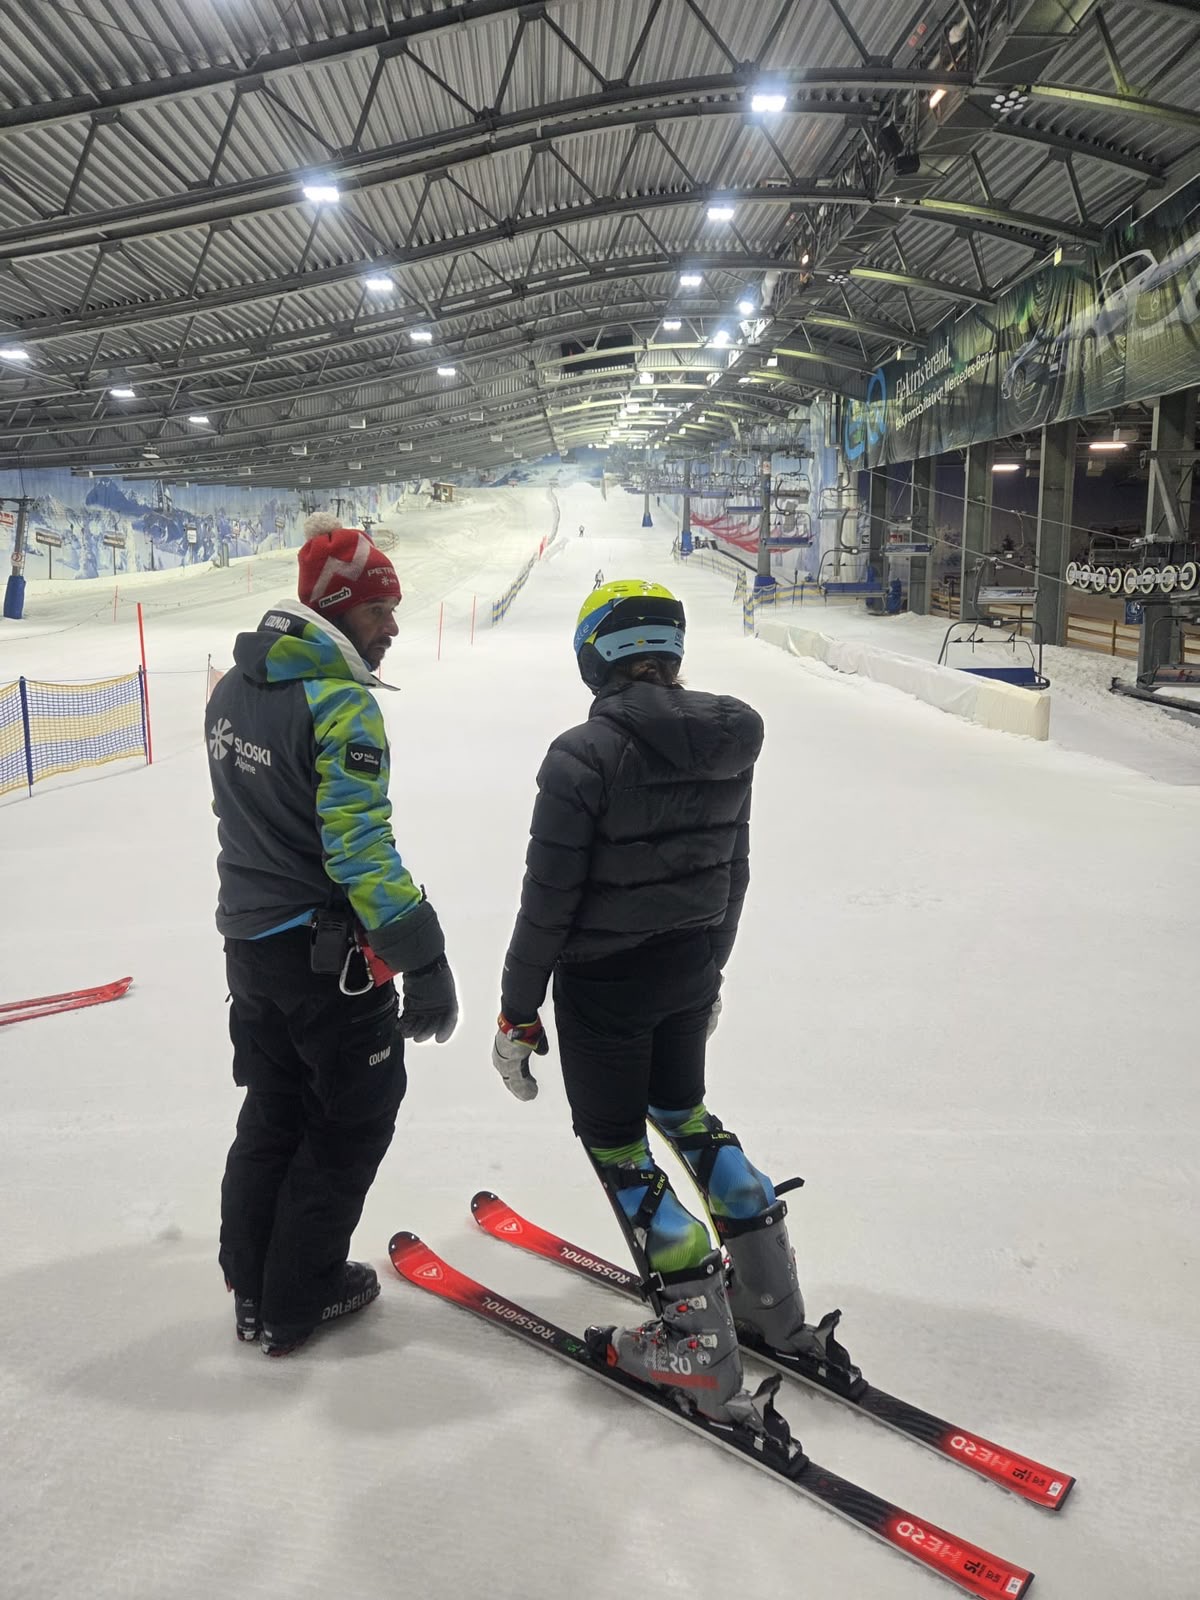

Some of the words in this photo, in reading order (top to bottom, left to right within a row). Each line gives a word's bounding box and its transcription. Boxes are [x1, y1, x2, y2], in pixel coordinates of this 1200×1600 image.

[320, 588, 350, 607] reusch
[234, 737, 271, 767] SLOSKI
[234, 756, 256, 774] Alpine
[560, 1247, 631, 1285] ROSSIGNOL
[482, 1297, 556, 1341] ROSSIGNOL
[951, 1435, 1010, 1471] HERO
[896, 1521, 962, 1564] HERO
[964, 1560, 981, 1574] SL
